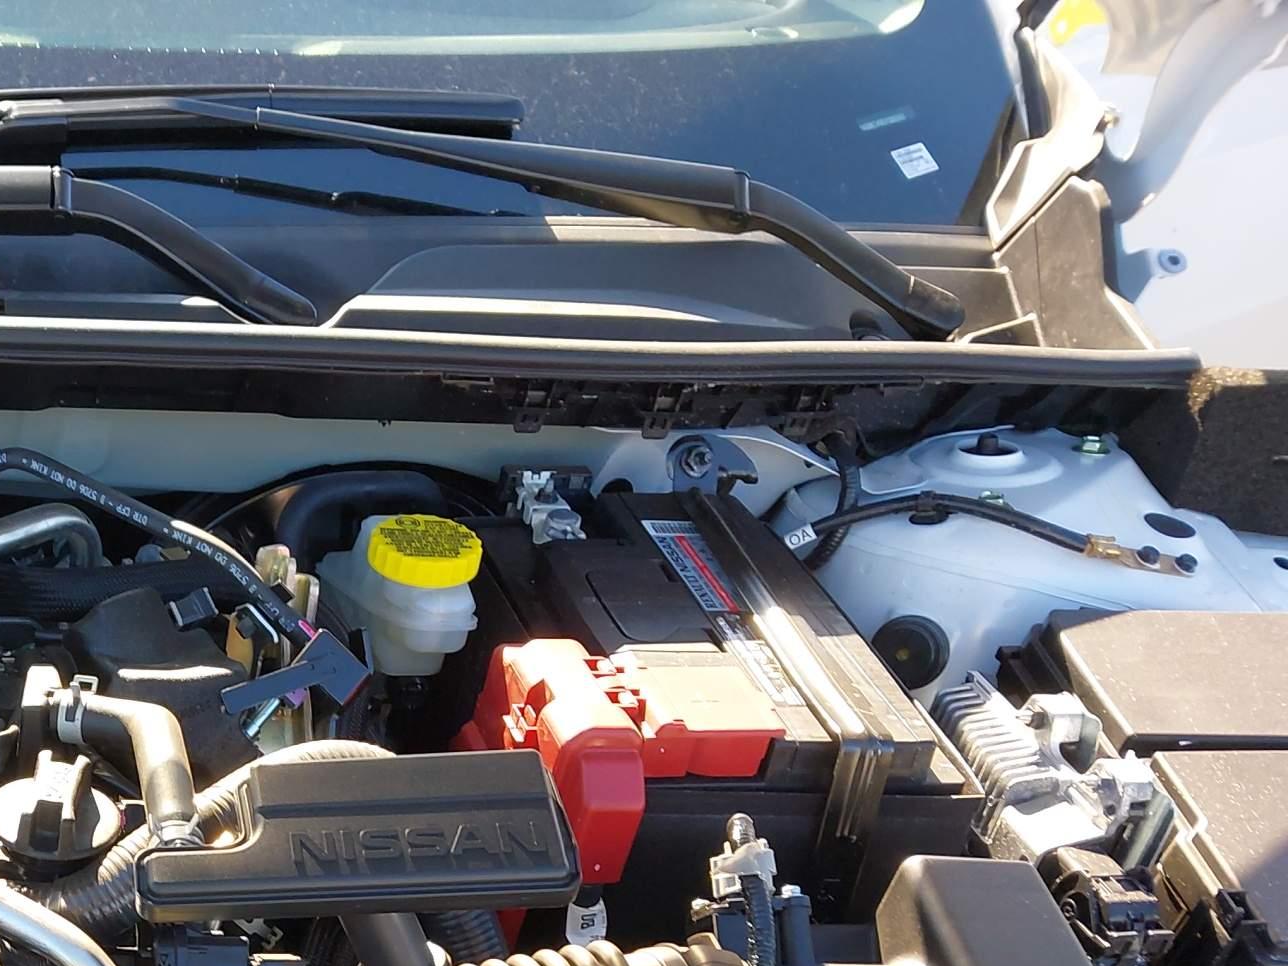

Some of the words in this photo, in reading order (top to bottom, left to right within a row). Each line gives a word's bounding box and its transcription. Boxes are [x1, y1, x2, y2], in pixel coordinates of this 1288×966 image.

[30, 458, 49, 476] KINK
[50, 470, 64, 484] NOT
[66, 478, 77, 491] DO
[172, 530, 193, 545] KINK
[196, 542, 213, 556] NOT
[655, 535, 692, 573] NISSAN
[214, 551, 228, 566] DO
[289, 820, 546, 864] NISSAN
